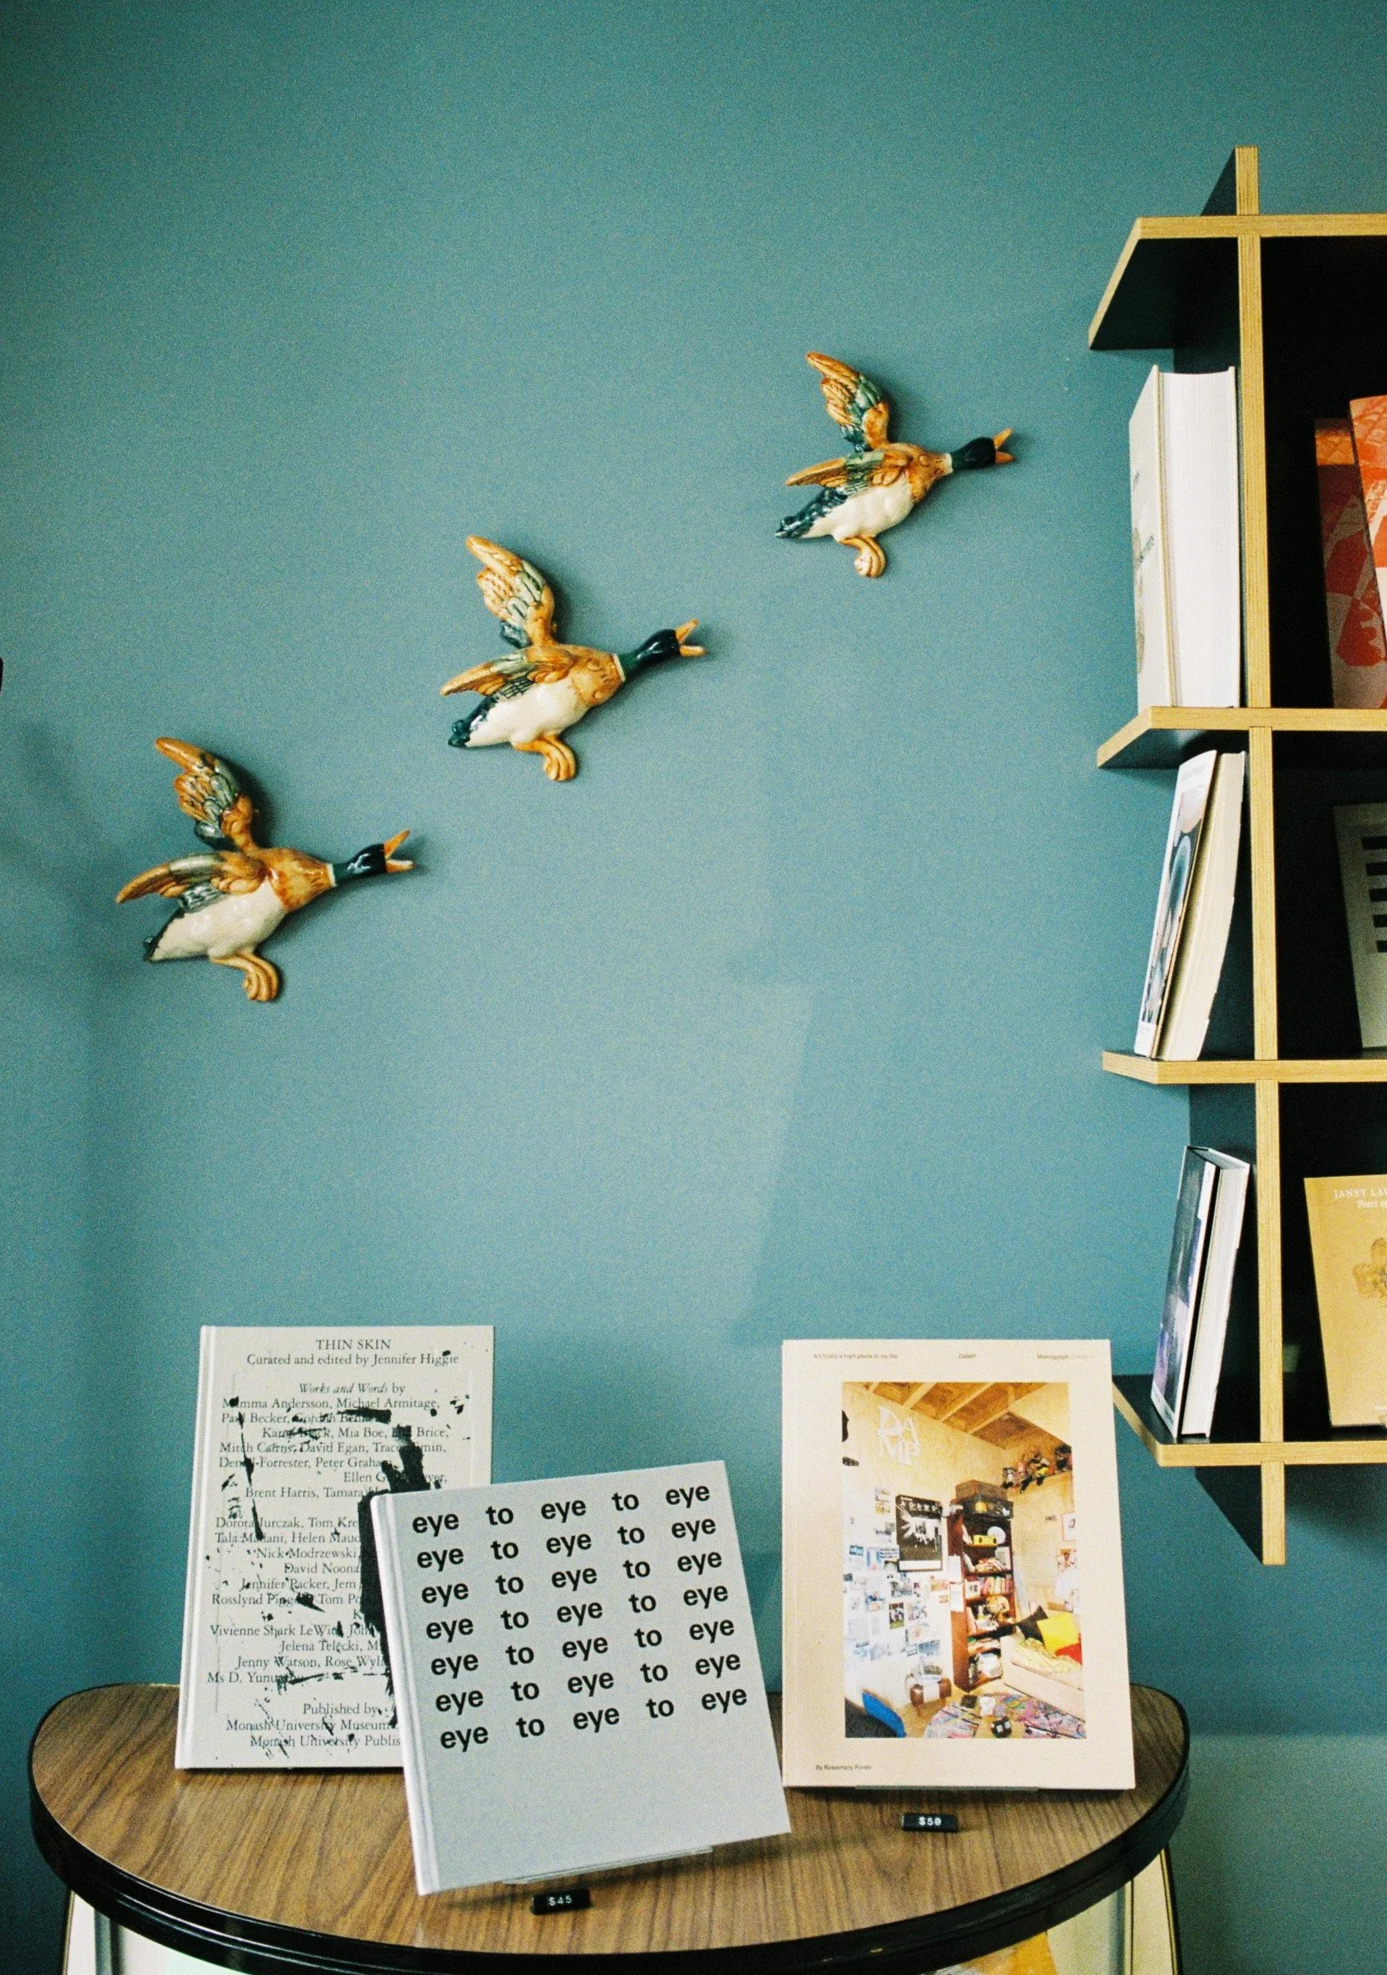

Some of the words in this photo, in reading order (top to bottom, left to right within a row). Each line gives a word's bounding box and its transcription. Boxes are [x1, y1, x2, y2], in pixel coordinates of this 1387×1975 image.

[1333, 1188, 1366, 1200] JANET
[315, 1339, 353, 1350] THIN
[356, 1339, 391, 1350] SKIN
[247, 1353, 291, 1366] Curated
[294, 1353, 315, 1366] and
[318, 1353, 352, 1366] edited
[356, 1354, 369, 1368] by
[371, 1353, 416, 1368] Jennifer
[420, 1353, 459, 1368] Higgie
[300, 1383, 330, 1394] Works
[333, 1383, 354, 1394] and
[358, 1383, 388, 1394] Words
[392, 1383, 405, 1397] by
[271, 1397, 333, 1410] Andersson,
[336, 1397, 380, 1409] Michael
[384, 1397, 440, 1411] Armitage,
[250, 1412, 290, 1425] Becker,
[338, 1427, 359, 1438] Mia
[363, 1427, 388, 1440] Boe,
[417, 1427, 449, 1440] Brice,
[301, 1442, 333, 1453] David
[338, 1442, 369, 1456] Egan,
[412, 1443, 447, 1454] min,
[315, 1456, 344, 1468] Peter
[343, 1471, 372, 1482] Ellen
[246, 1487, 276, 1498] Brent
[281, 1487, 319, 1499] Harris,
[324, 1487, 366, 1498] Tamara
[412, 1513, 459, 1538] eye
[485, 1505, 514, 1526] to
[540, 1499, 587, 1524] eye
[611, 1492, 640, 1512] to
[665, 1485, 710, 1509] eye
[216, 1517, 254, 1528] Dorota
[308, 1517, 335, 1528] Tom
[338, 1517, 359, 1528] Kre
[215, 1532, 238, 1543] Tala
[292, 1532, 325, 1543] Helen
[416, 1548, 464, 1573] eye
[490, 1540, 519, 1561] to
[546, 1533, 592, 1558] eye
[616, 1526, 645, 1545] to
[671, 1518, 716, 1542] eye
[257, 1547, 285, 1558] Nick
[284, 1562, 317, 1574] David
[322, 1562, 360, 1574] Noona
[290, 1578, 329, 1590] Packer,
[333, 1578, 356, 1592] Jem
[421, 1582, 469, 1608] eye
[495, 1575, 524, 1595] to
[551, 1567, 598, 1592] eye
[622, 1559, 651, 1579] to
[677, 1551, 722, 1576] eye
[212, 1593, 262, 1607] Rosslynd
[318, 1593, 344, 1604] Tom
[425, 1618, 474, 1644] eye
[499, 1610, 529, 1630] to
[556, 1602, 603, 1627] eye
[628, 1593, 657, 1614] to
[683, 1585, 729, 1610] eye
[210, 1624, 260, 1636] Vivienne
[264, 1625, 295, 1638] Shark
[278, 1641, 315, 1653] Jelena
[319, 1640, 363, 1653] Telecki,
[430, 1654, 479, 1680] eye
[505, 1645, 535, 1666] to
[562, 1636, 609, 1662] eye
[633, 1628, 663, 1648] to
[689, 1619, 735, 1644] eye
[236, 1656, 270, 1669] Jenny
[274, 1656, 321, 1669] Watson,
[325, 1656, 352, 1667] Rose
[207, 1672, 225, 1683] Ms
[229, 1672, 242, 1683] D.
[435, 1690, 484, 1716] eye
[510, 1681, 540, 1702] to
[567, 1672, 614, 1698] eye
[639, 1663, 669, 1684] to
[695, 1653, 741, 1679] eye
[303, 1702, 359, 1714] Published
[364, 1702, 378, 1718] by
[226, 1719, 272, 1731] Monash
[340, 1719, 390, 1730] Museum
[439, 1726, 489, 1753] eye
[515, 1717, 545, 1738] to
[572, 1707, 620, 1734] eye
[645, 1698, 675, 1719] to
[701, 1688, 747, 1714] eye
[365, 1734, 401, 1746] Publis
[918, 1816, 942, 1827] $50
[548, 1894, 572, 1907] $45
